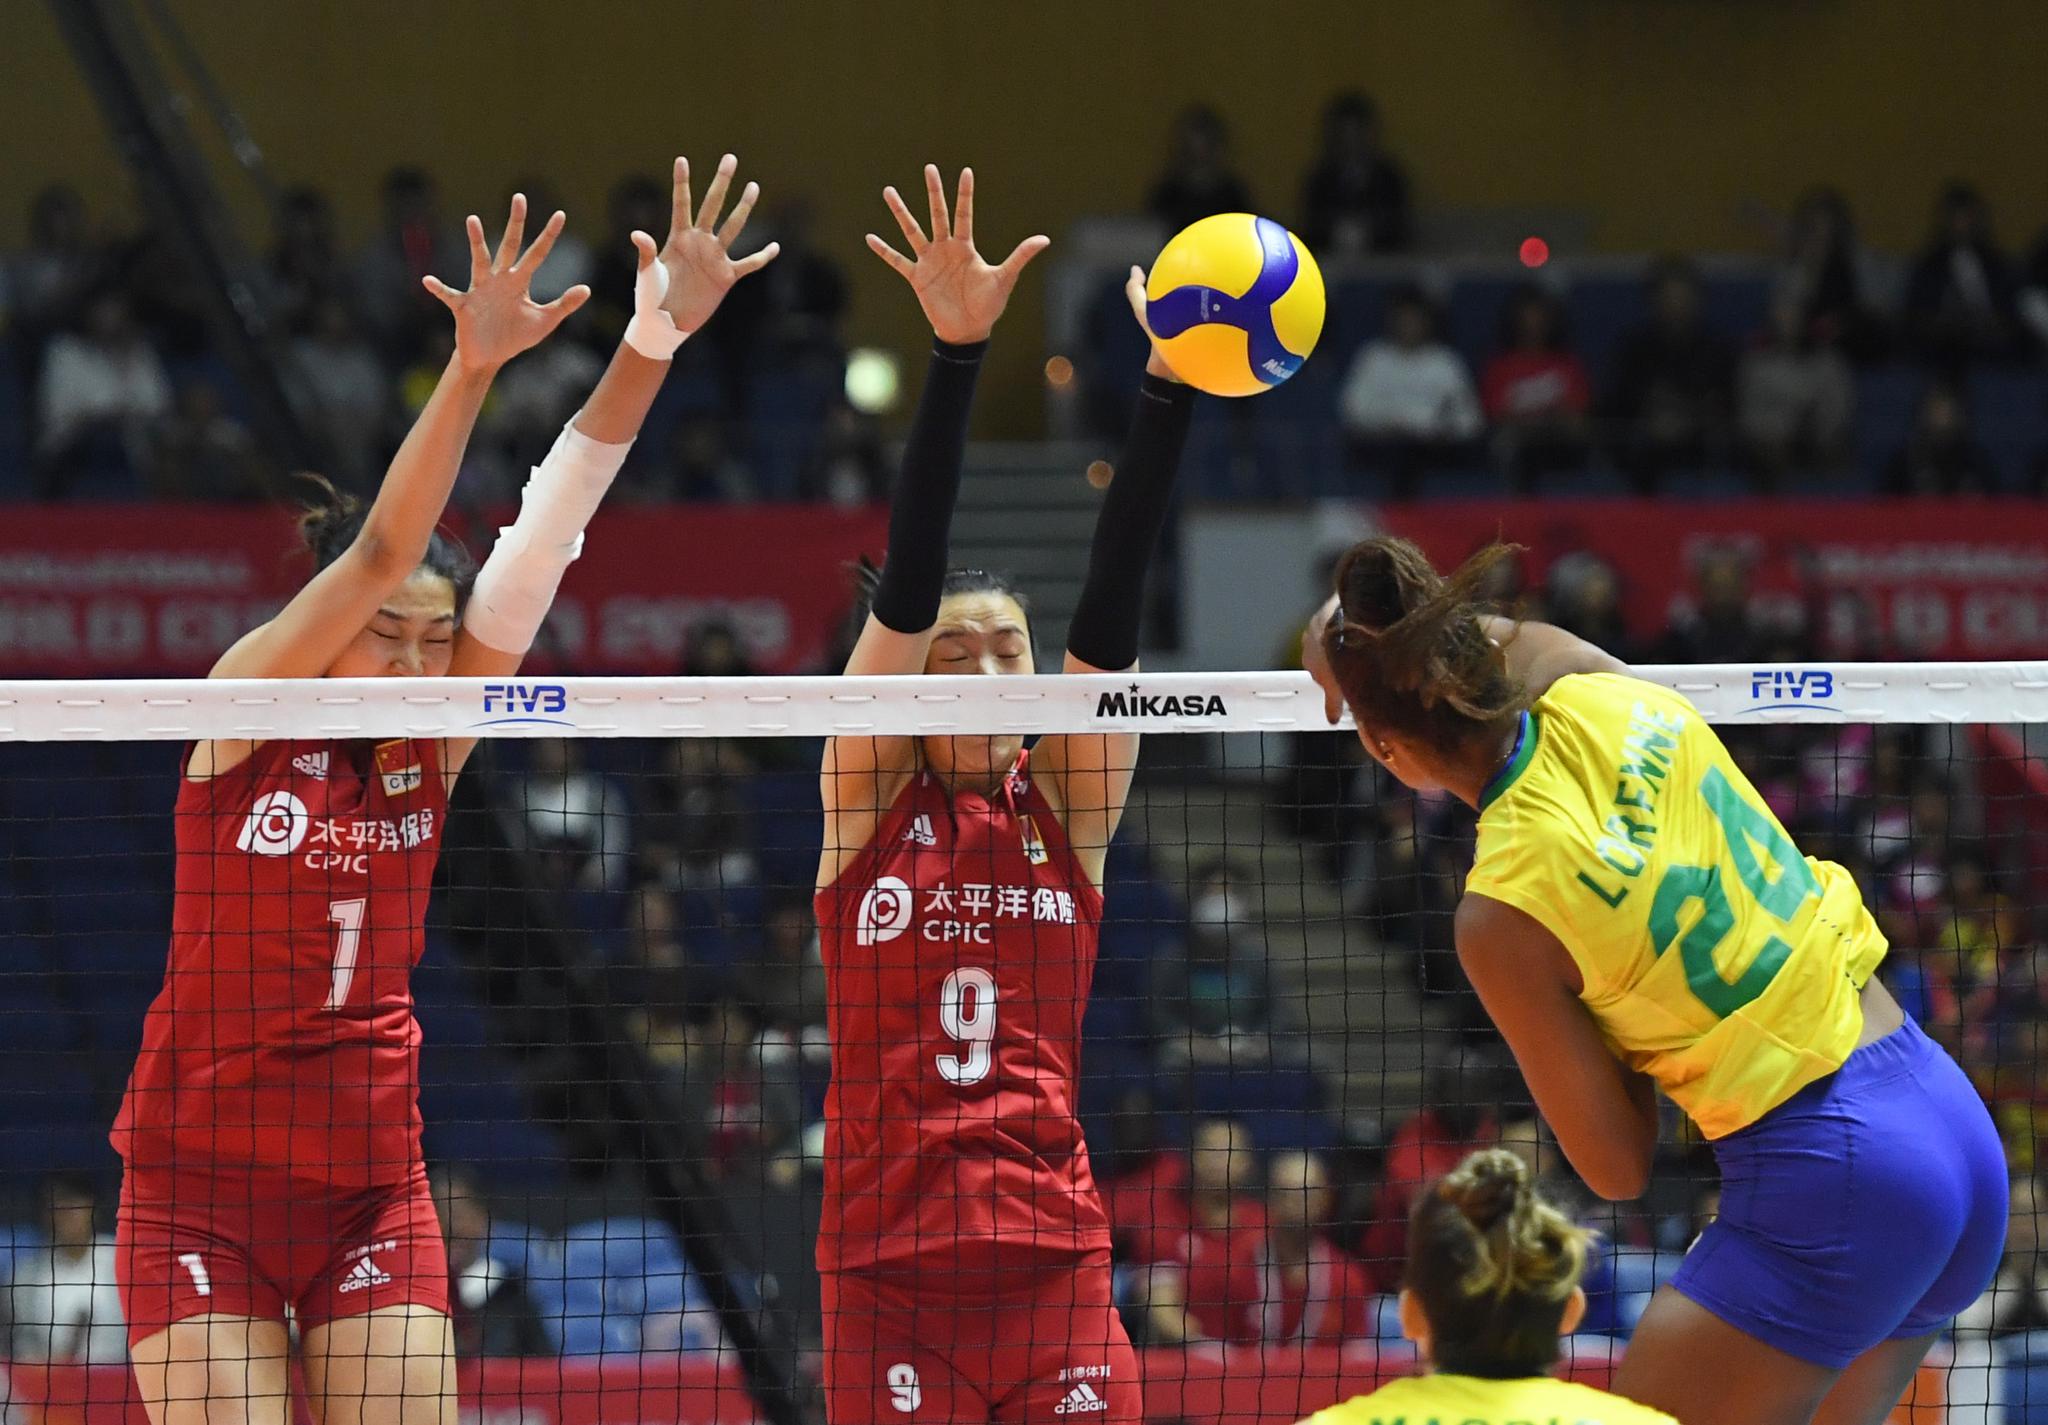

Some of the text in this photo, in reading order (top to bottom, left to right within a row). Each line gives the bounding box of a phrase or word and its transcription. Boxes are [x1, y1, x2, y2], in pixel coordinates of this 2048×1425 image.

[484, 685, 566, 712] FIVB
[1096, 682, 1227, 717] MIKASA
[1752, 671, 1833, 698] FIVB
[304, 849, 368, 874] CPIC
[924, 882, 1077, 924] 太平洋保险
[1648, 763, 1824, 1021] 24
[923, 919, 991, 944] CPIC
[320, 898, 366, 1011] 1
[935, 966, 999, 1086] 9
[178, 1252, 210, 1296] 1
[887, 1363, 921, 1412] 9
[1054, 1400, 1108, 1414] adidas
